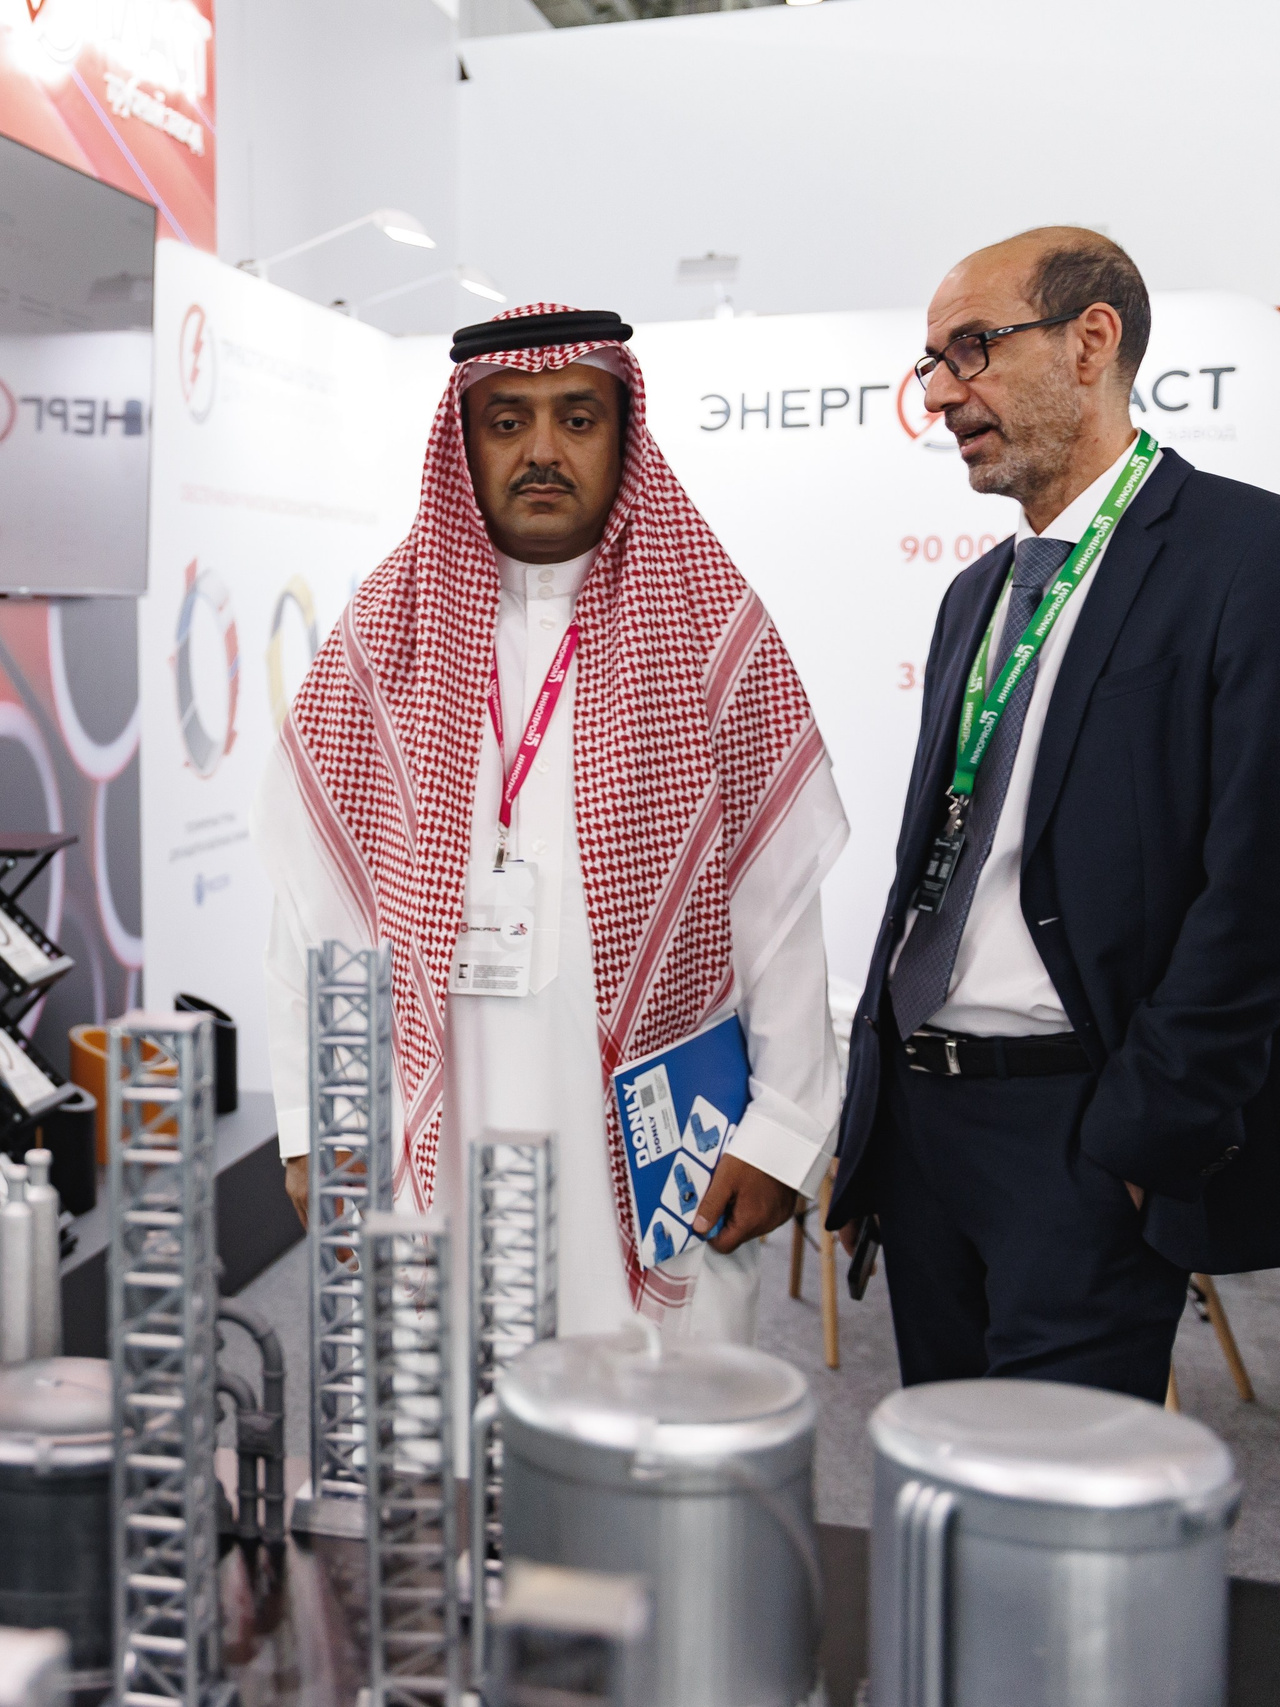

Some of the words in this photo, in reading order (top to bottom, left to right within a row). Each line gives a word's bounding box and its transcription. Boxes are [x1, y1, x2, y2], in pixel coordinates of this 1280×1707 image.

[1114, 463, 1147, 508] INNOPROM
[900, 535, 943, 563] 90
[953, 533, 1016, 563] 00
[1072, 520, 1111, 575] ИННОПРОМ
[1035, 587, 1070, 637] INNOPROM
[997, 649, 1032, 704] ИННОПРОМ
[622, 1083, 651, 1169] DONLY
